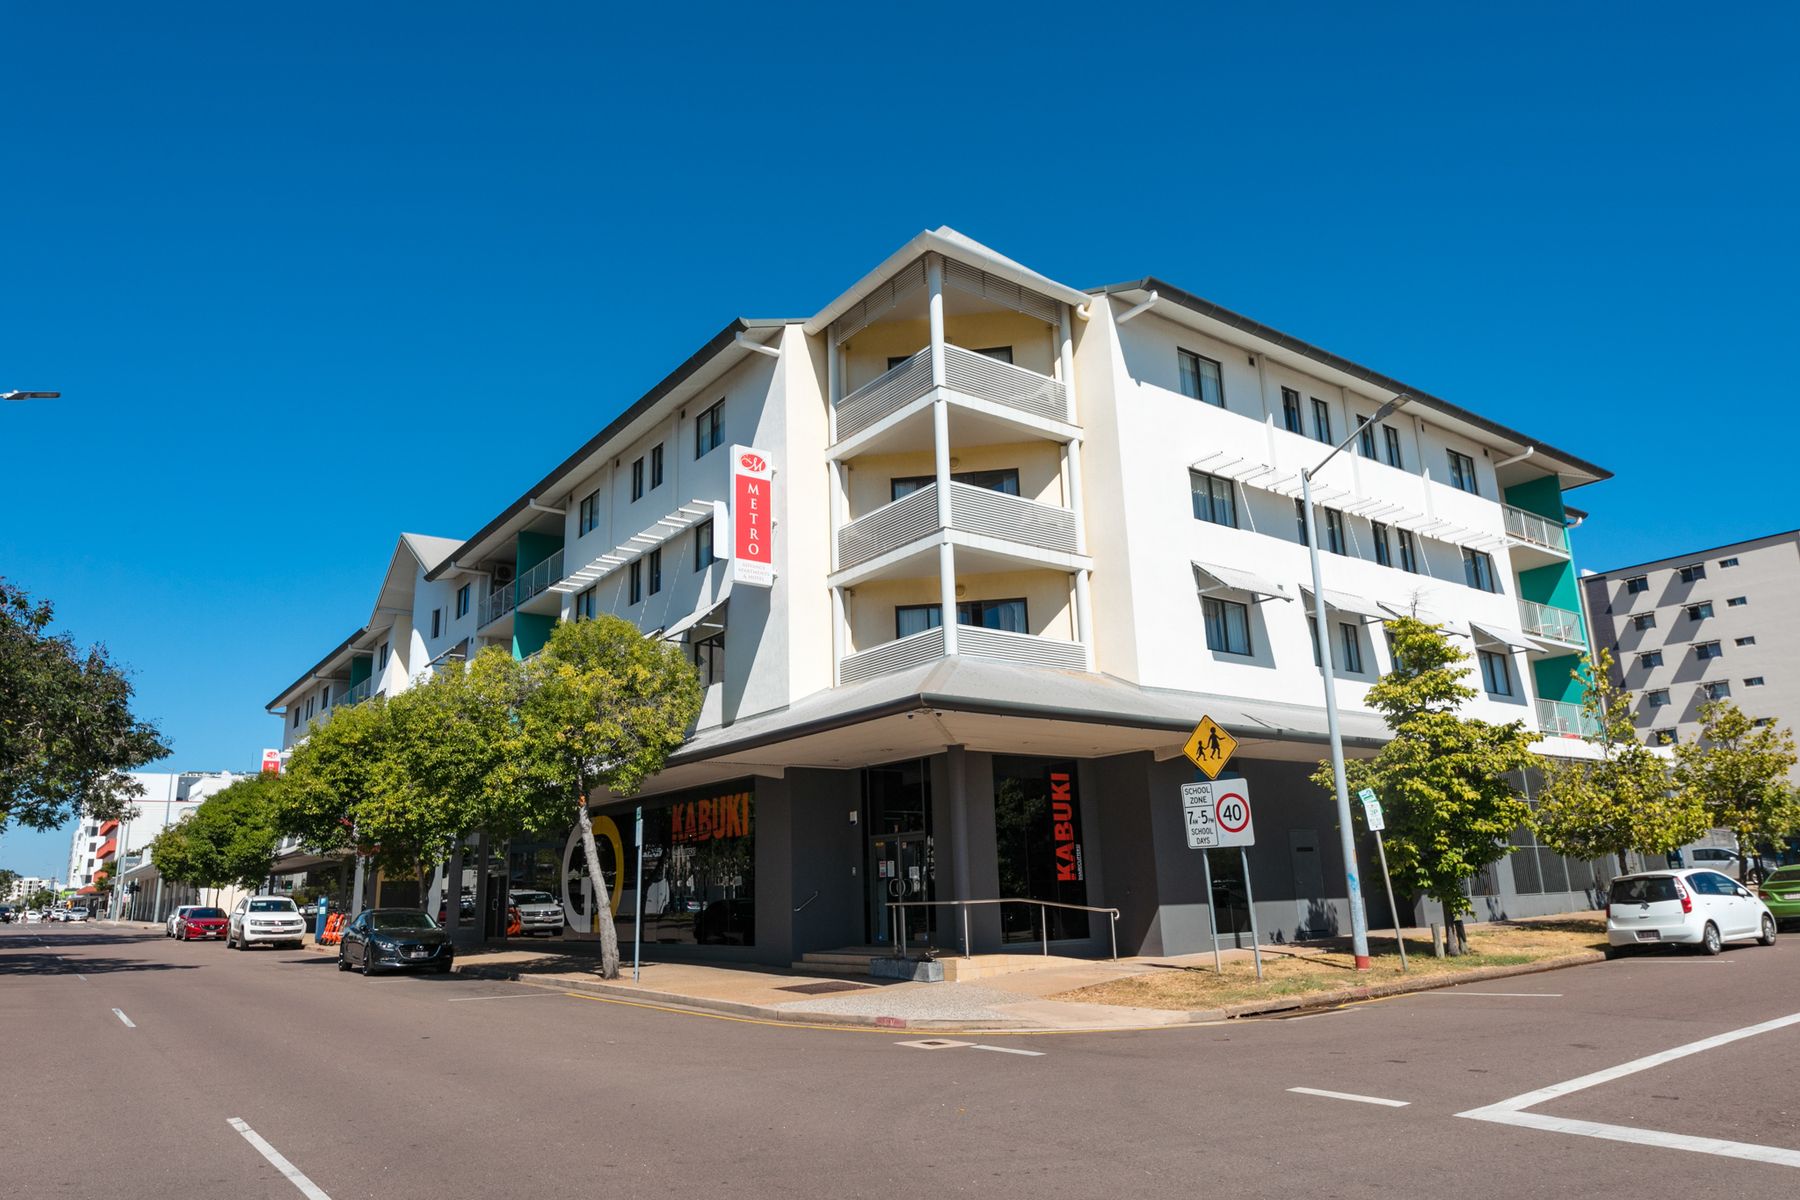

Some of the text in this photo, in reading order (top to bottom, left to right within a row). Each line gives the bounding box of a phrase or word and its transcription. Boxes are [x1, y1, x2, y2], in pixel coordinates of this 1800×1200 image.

[747, 482, 760, 556] METRO
[1184, 786, 1210, 796] SCHOOL
[1189, 796, 1208, 805] ZONE
[671, 791, 749, 843] KABUKI
[1223, 803, 1242, 822] 40
[1050, 772, 1076, 881] KABUKI
[1191, 827, 1214, 836] SCHOOL
[1196, 837, 1211, 845] DAYS
